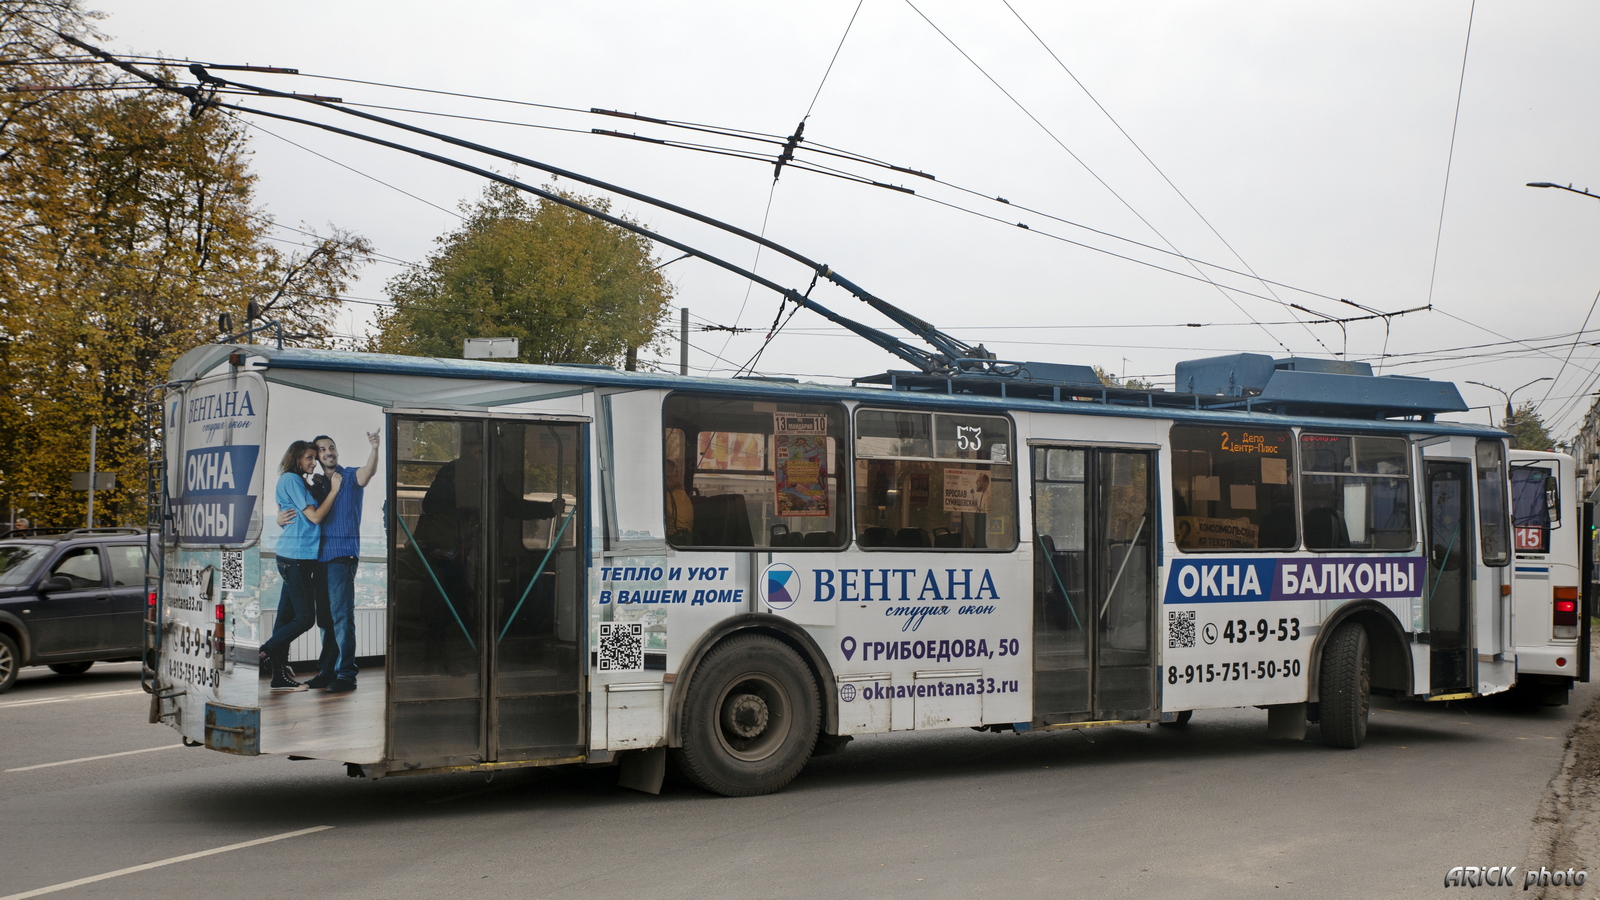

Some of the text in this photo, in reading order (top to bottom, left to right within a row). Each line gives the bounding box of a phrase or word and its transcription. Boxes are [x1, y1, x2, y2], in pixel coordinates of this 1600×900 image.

[188, 390, 256, 424] ВЕНТАНА
[202, 419, 253, 444] студия окон
[776, 416, 826, 431] 13 10
[956, 425, 982, 451] 53
[1221, 431, 1265, 450] 2 Депо
[187, 451, 236, 492] ОКНА
[945, 489, 968, 498] ЯРОСЛАВ
[170, 502, 235, 538] БАЛКОНЫ
[1179, 519, 1256, 547] 2 КОМСОМОЛЬСКАЯ
[1517, 528, 1540, 547] 15
[600, 567, 729, 581] ТЕПЛО И УЮТ
[811, 568, 1000, 602] ВЕНТАНА
[1177, 562, 1415, 598] ОКНА БАЛКОНЫ
[598, 589, 744, 606] В ВАШЕМ ДОМЕ
[885, 604, 996, 632] студия окон
[1223, 617, 1301, 644] 43-9-53
[180, 626, 213, 659] 43-9-5
[863, 638, 1020, 662] ГРИБОЕДОВА, 50
[169, 658, 220, 689] 8-915-751-50-50
[1167, 658, 1301, 685] 8-915-751-50-50
[862, 677, 1019, 700] oknaventana33.ru
